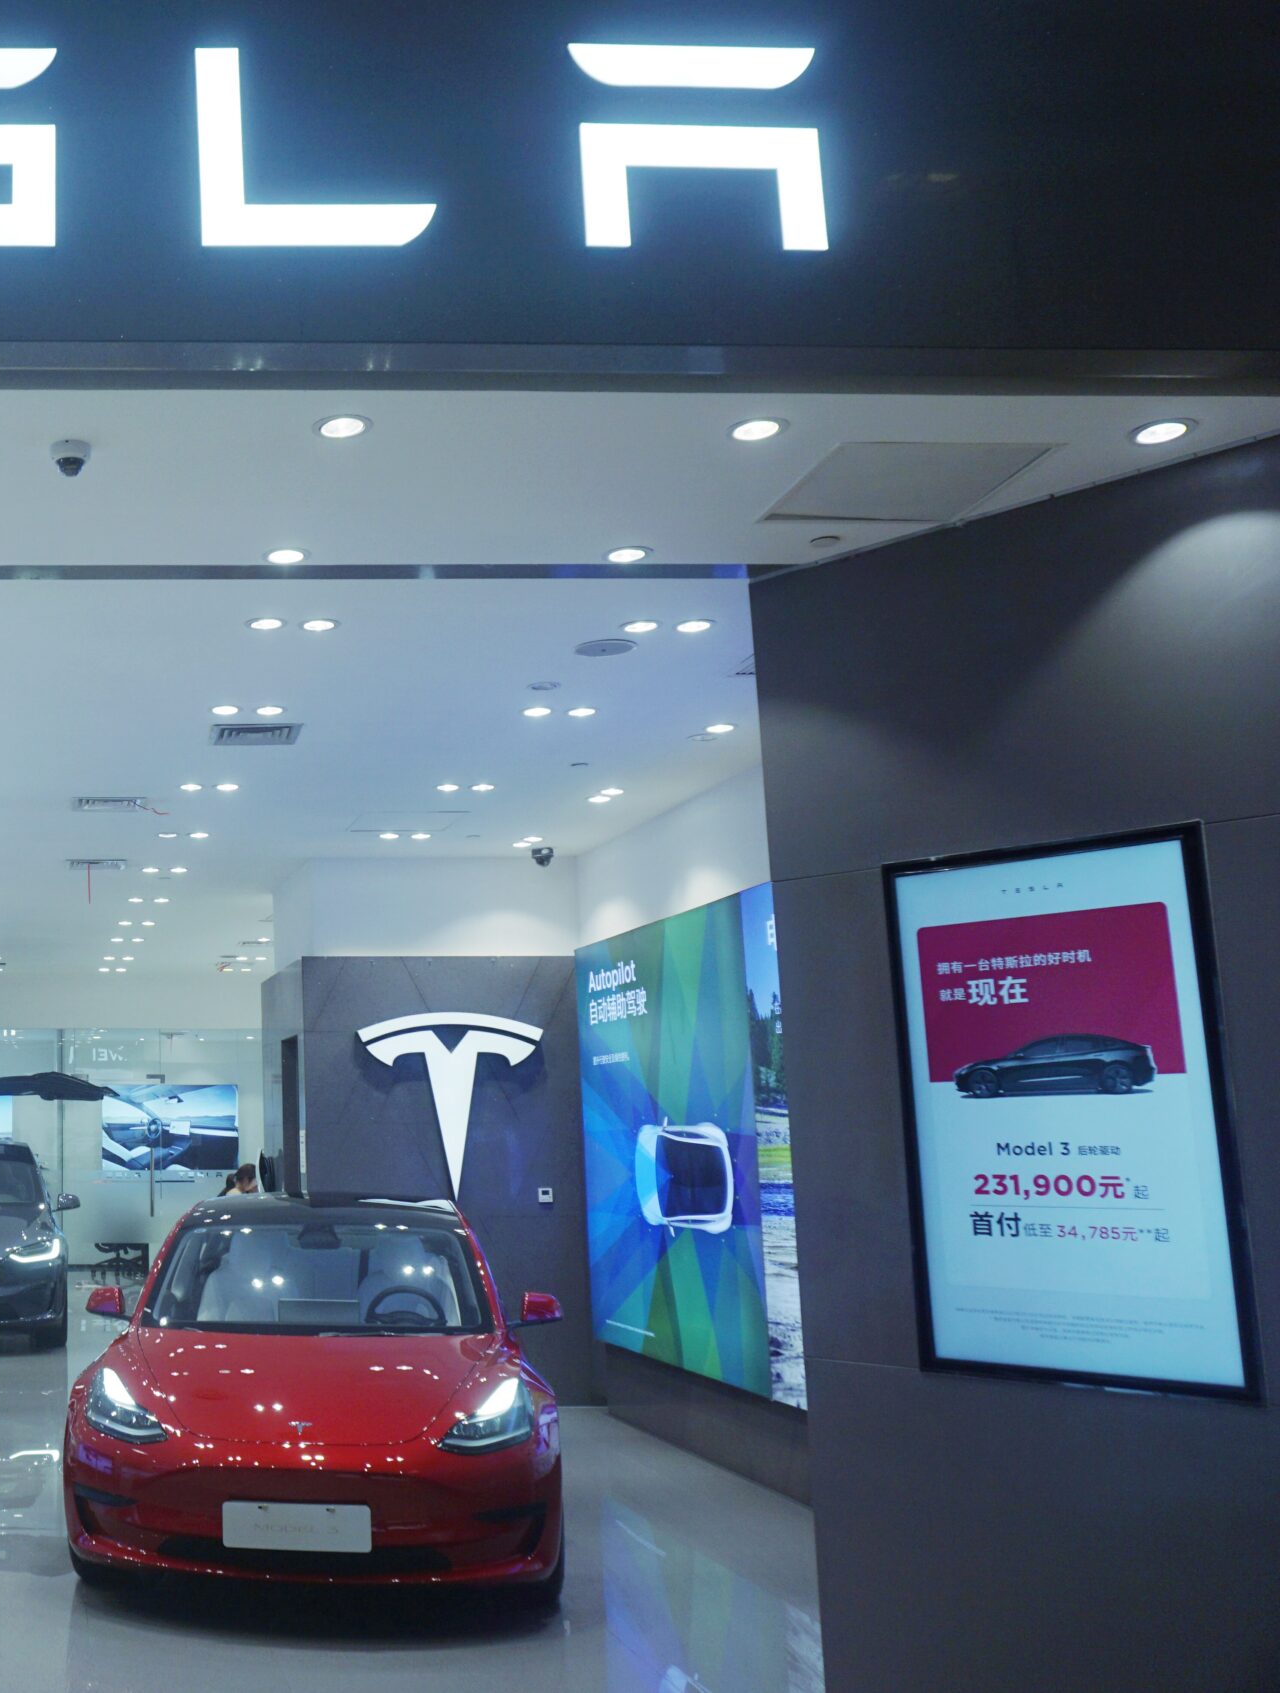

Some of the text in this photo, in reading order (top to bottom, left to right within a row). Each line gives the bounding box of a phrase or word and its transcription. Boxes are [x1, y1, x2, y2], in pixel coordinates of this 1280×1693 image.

[1000, 882, 1064, 894] TESLA
[936, 949, 1092, 975] 拥有一台特斯拉的好时机
[588, 960, 637, 993] Autopilot
[939, 976, 1030, 1006] 就是现在
[589, 986, 648, 1026] 自动辅助驾驶
[996, 1142, 1121, 1156] Model 3 后轮驱动
